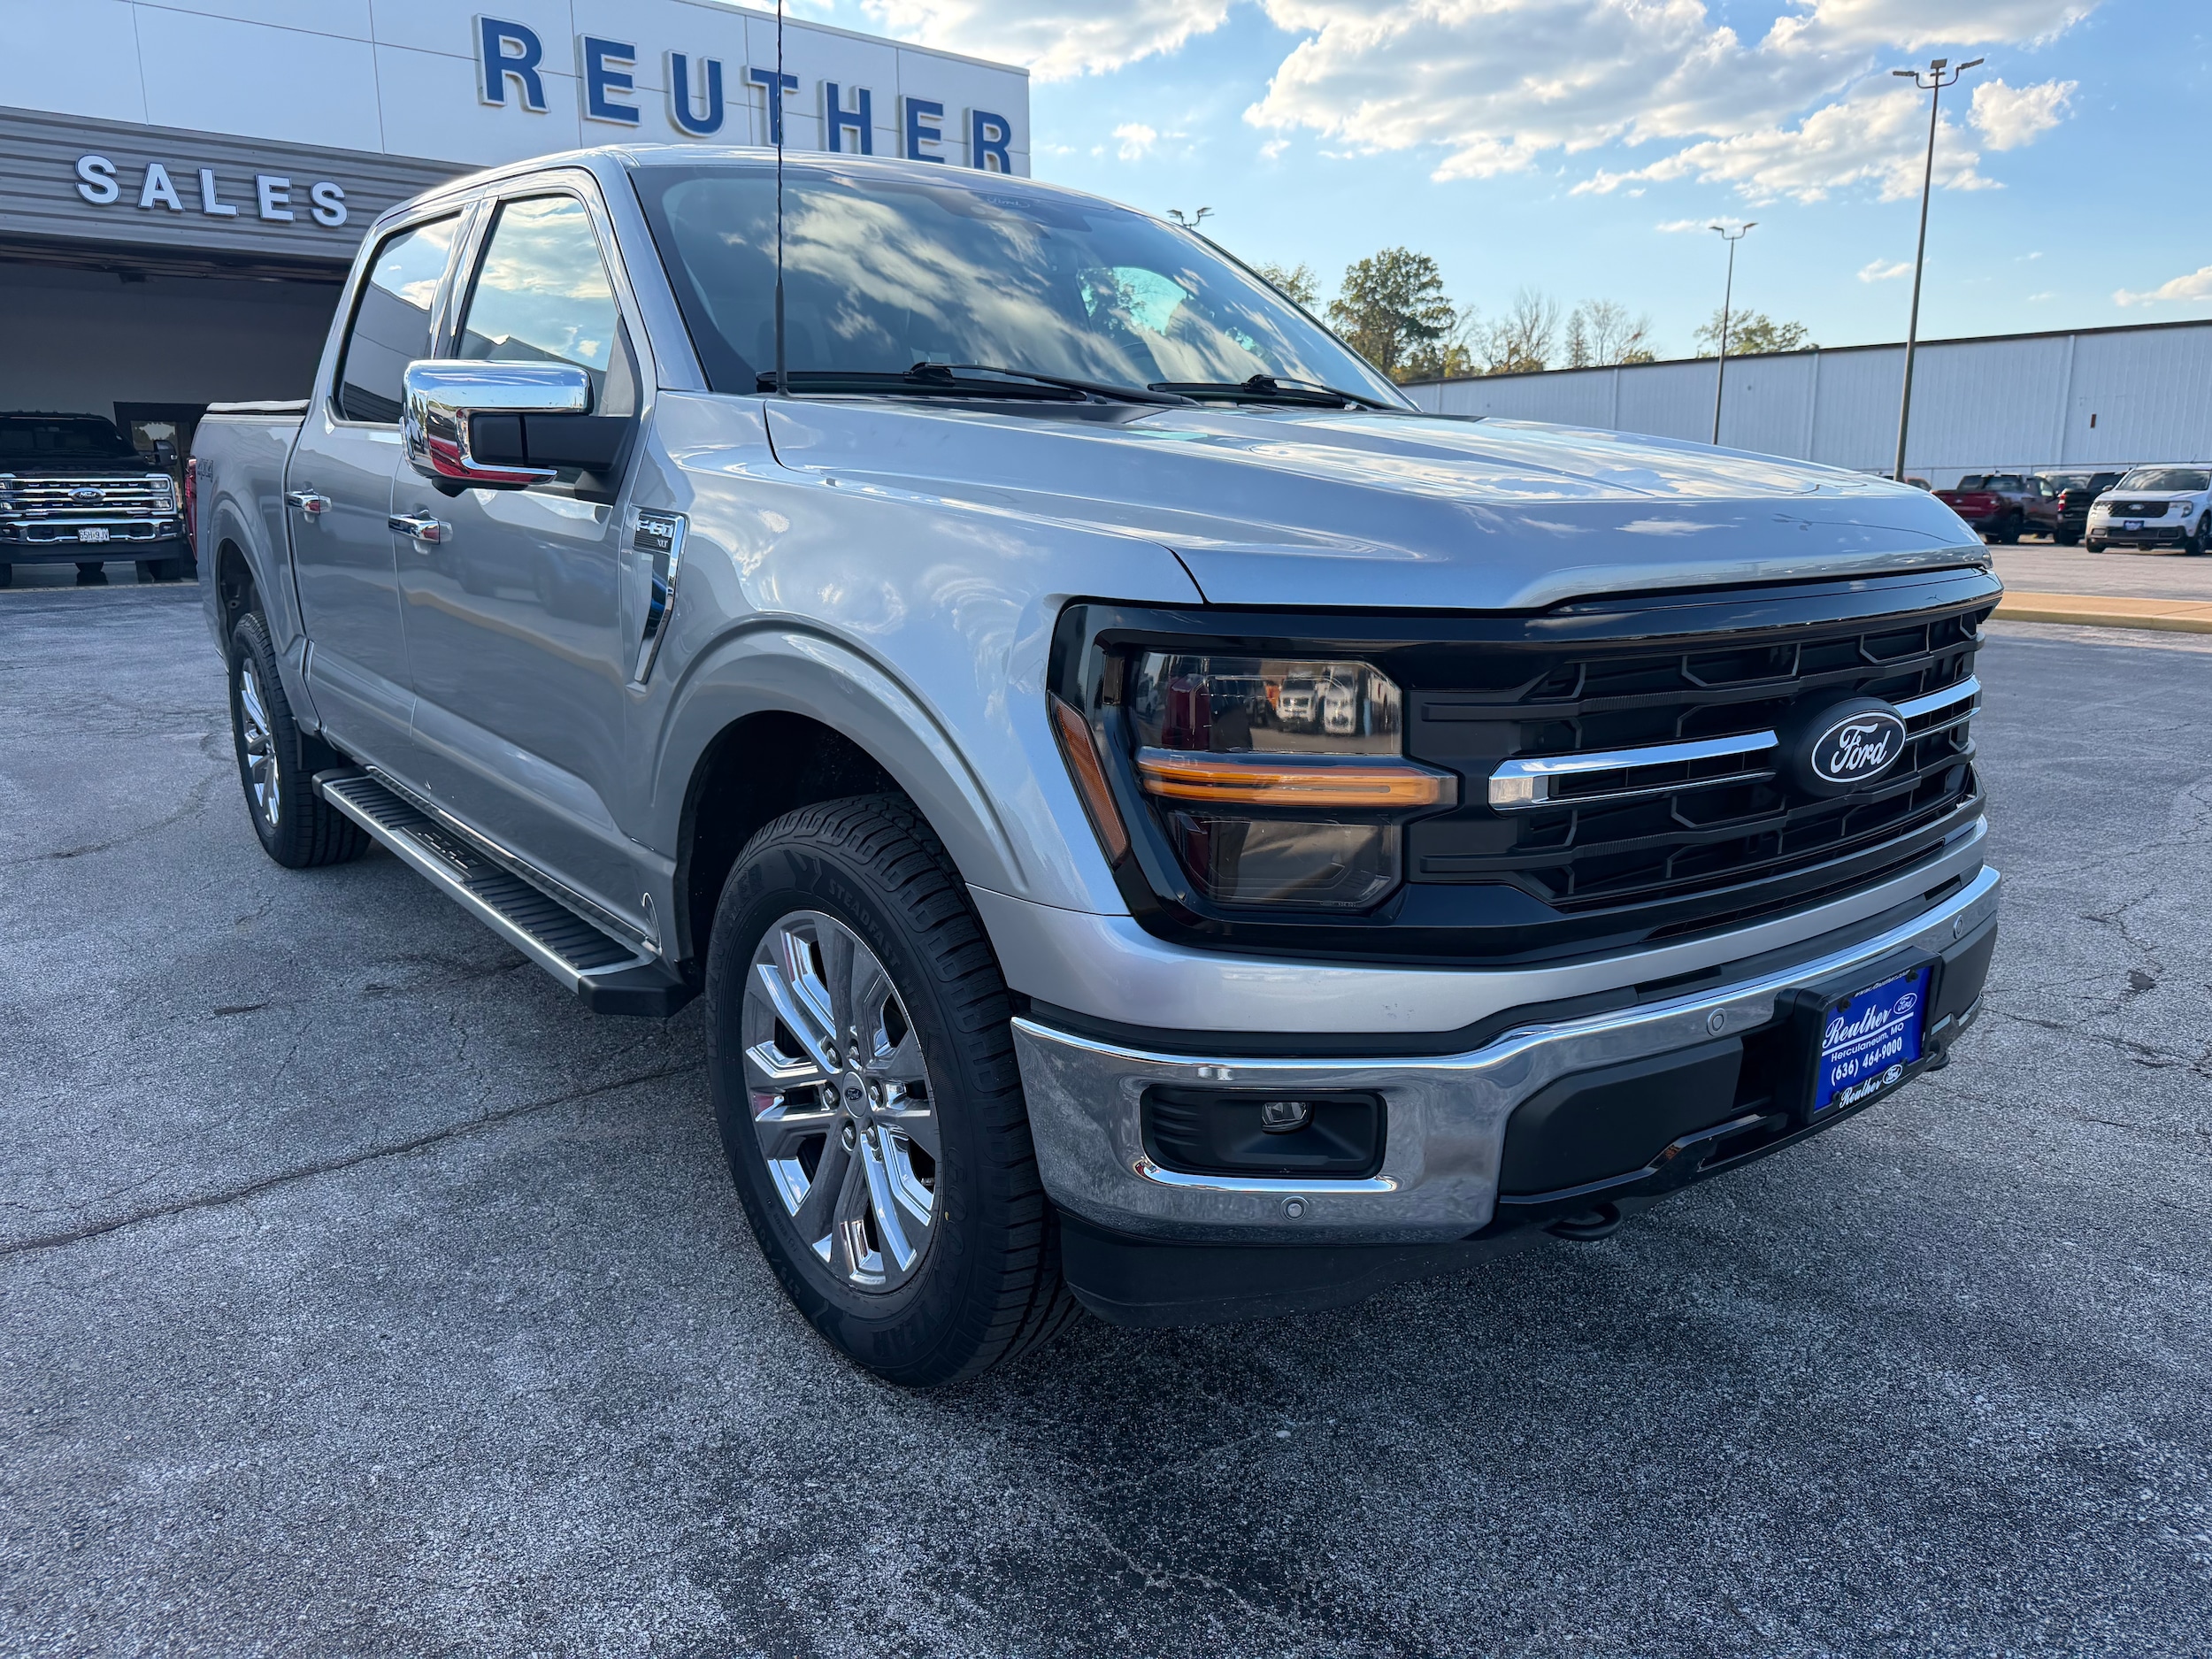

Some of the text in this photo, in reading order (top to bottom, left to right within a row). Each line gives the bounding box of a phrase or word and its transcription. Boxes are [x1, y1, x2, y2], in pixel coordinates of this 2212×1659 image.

[475, 12, 1013, 174] REUTHER
[75, 154, 349, 227] SALES
[1830, 723, 1892, 774] Ford
[827, 877, 902, 969] STEADFAST
[1822, 1004, 1892, 1049] Reuther
[1831, 1022, 1905, 1063] Herculaneum, MO
[1831, 1057, 1859, 1087] (636)
[1839, 1077, 1883, 1109] Reuther
